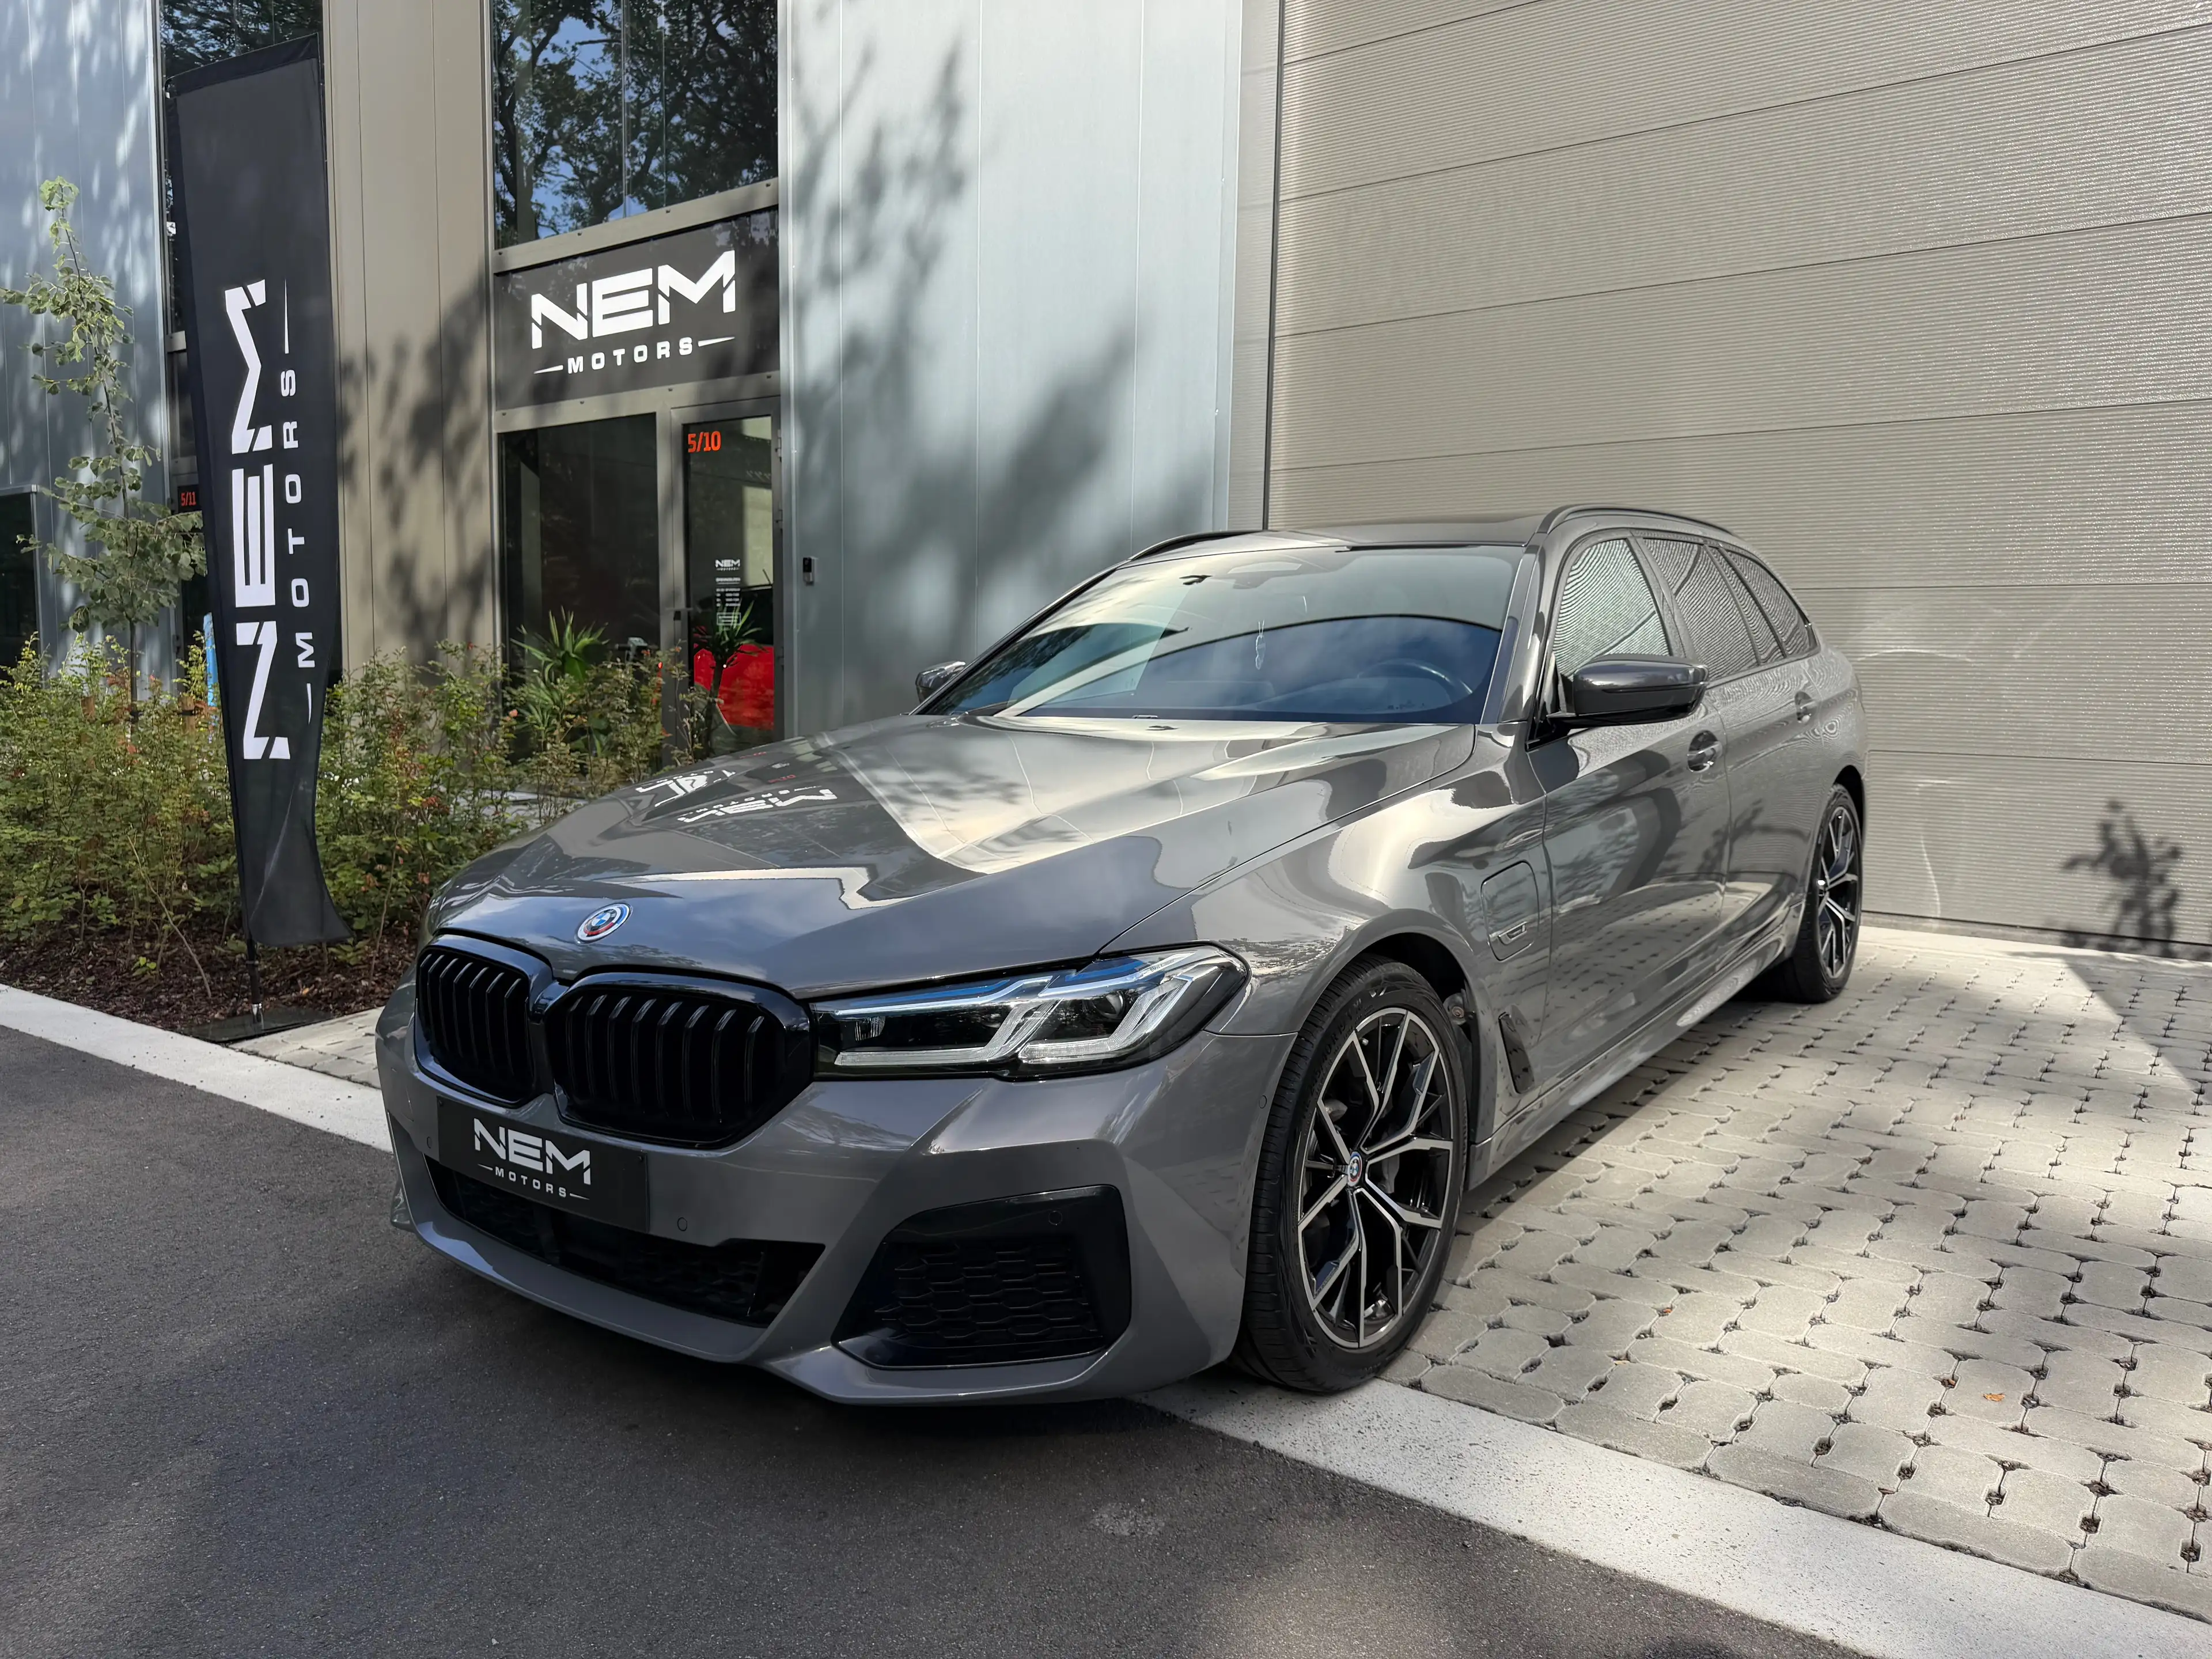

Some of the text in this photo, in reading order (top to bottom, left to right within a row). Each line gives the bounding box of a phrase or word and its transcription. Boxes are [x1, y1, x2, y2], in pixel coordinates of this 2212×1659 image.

[531, 249, 736, 349] NEM
[567, 337, 692, 374] MOTORS
[688, 431, 721, 453] 5/10
[181, 492, 196, 506] 5/11
[224, 279, 291, 760] NEM
[281, 369, 316, 668] MOTORS
[715, 559, 740, 567] NEM
[474, 1118, 591, 1185] NEM
[495, 1166, 566, 1198] MOTORS
